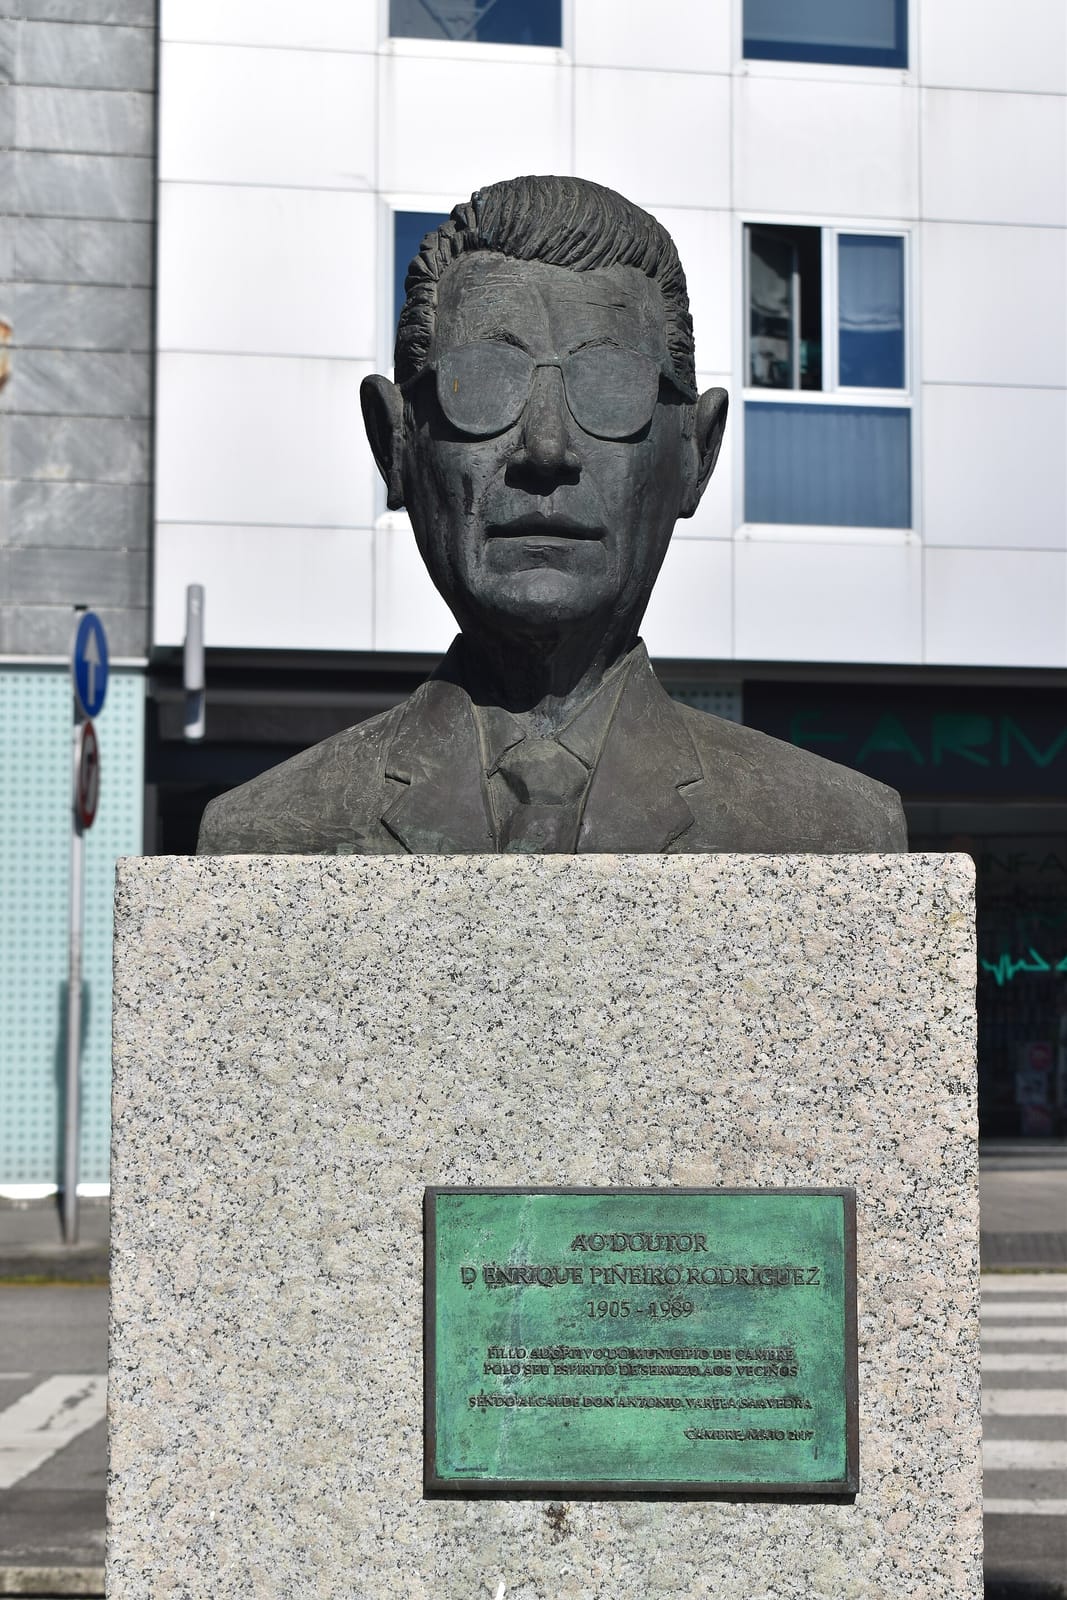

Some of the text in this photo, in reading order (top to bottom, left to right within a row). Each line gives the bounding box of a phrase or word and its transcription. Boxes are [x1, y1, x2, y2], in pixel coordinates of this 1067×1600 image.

[571, 1232, 708, 1252] AO DOUTOR
[483, 1266, 584, 1288] ENRIQUE
[587, 1300, 630, 1318] 1905
[649, 1300, 694, 1318] 1989
[487, 1346, 527, 1359] FILLO
[530, 1346, 604, 1360] ADOPTIVO
[713, 1347, 732, 1360] DE
[735, 1347, 795, 1361] CAMBRE
[482, 1363, 521, 1376] POLO
[523, 1363, 549, 1376] SEU
[619, 1363, 638, 1376] DE
[703, 1364, 732, 1377] AOS
[583, 1395, 615, 1408] DON
[617, 1395, 681, 1409] ANTONIO
[739, 1396, 812, 1409] SAAVEDRA
